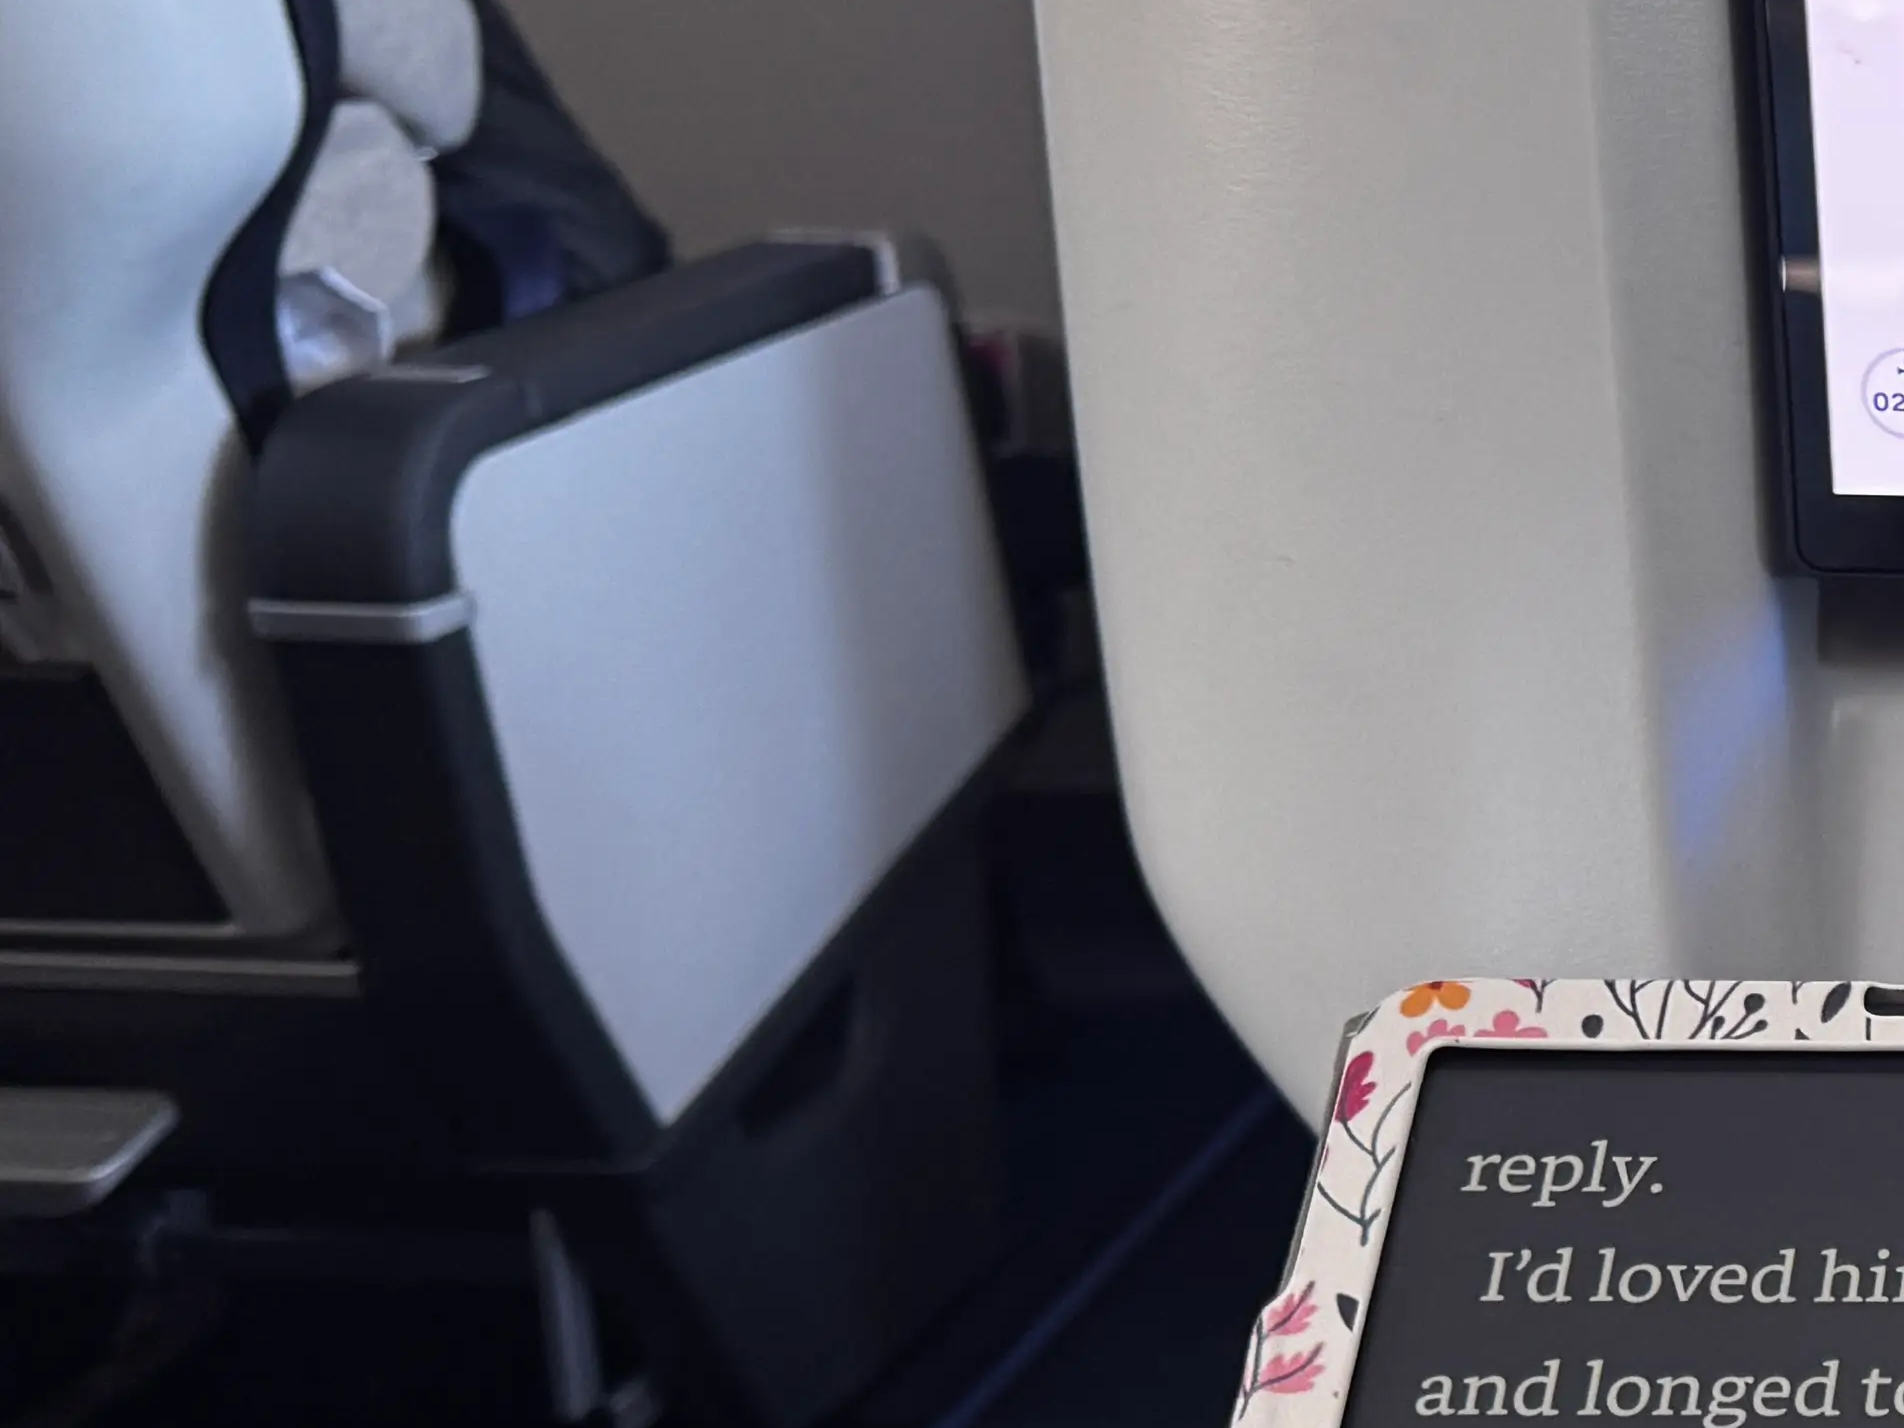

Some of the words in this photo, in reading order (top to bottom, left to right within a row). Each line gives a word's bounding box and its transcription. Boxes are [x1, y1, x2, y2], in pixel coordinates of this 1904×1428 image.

[1461, 1140, 1662, 1207] reply.
[1480, 1247, 1573, 1302] I’d
[1589, 1248, 1796, 1303] loved
[1416, 1359, 1560, 1416] and
